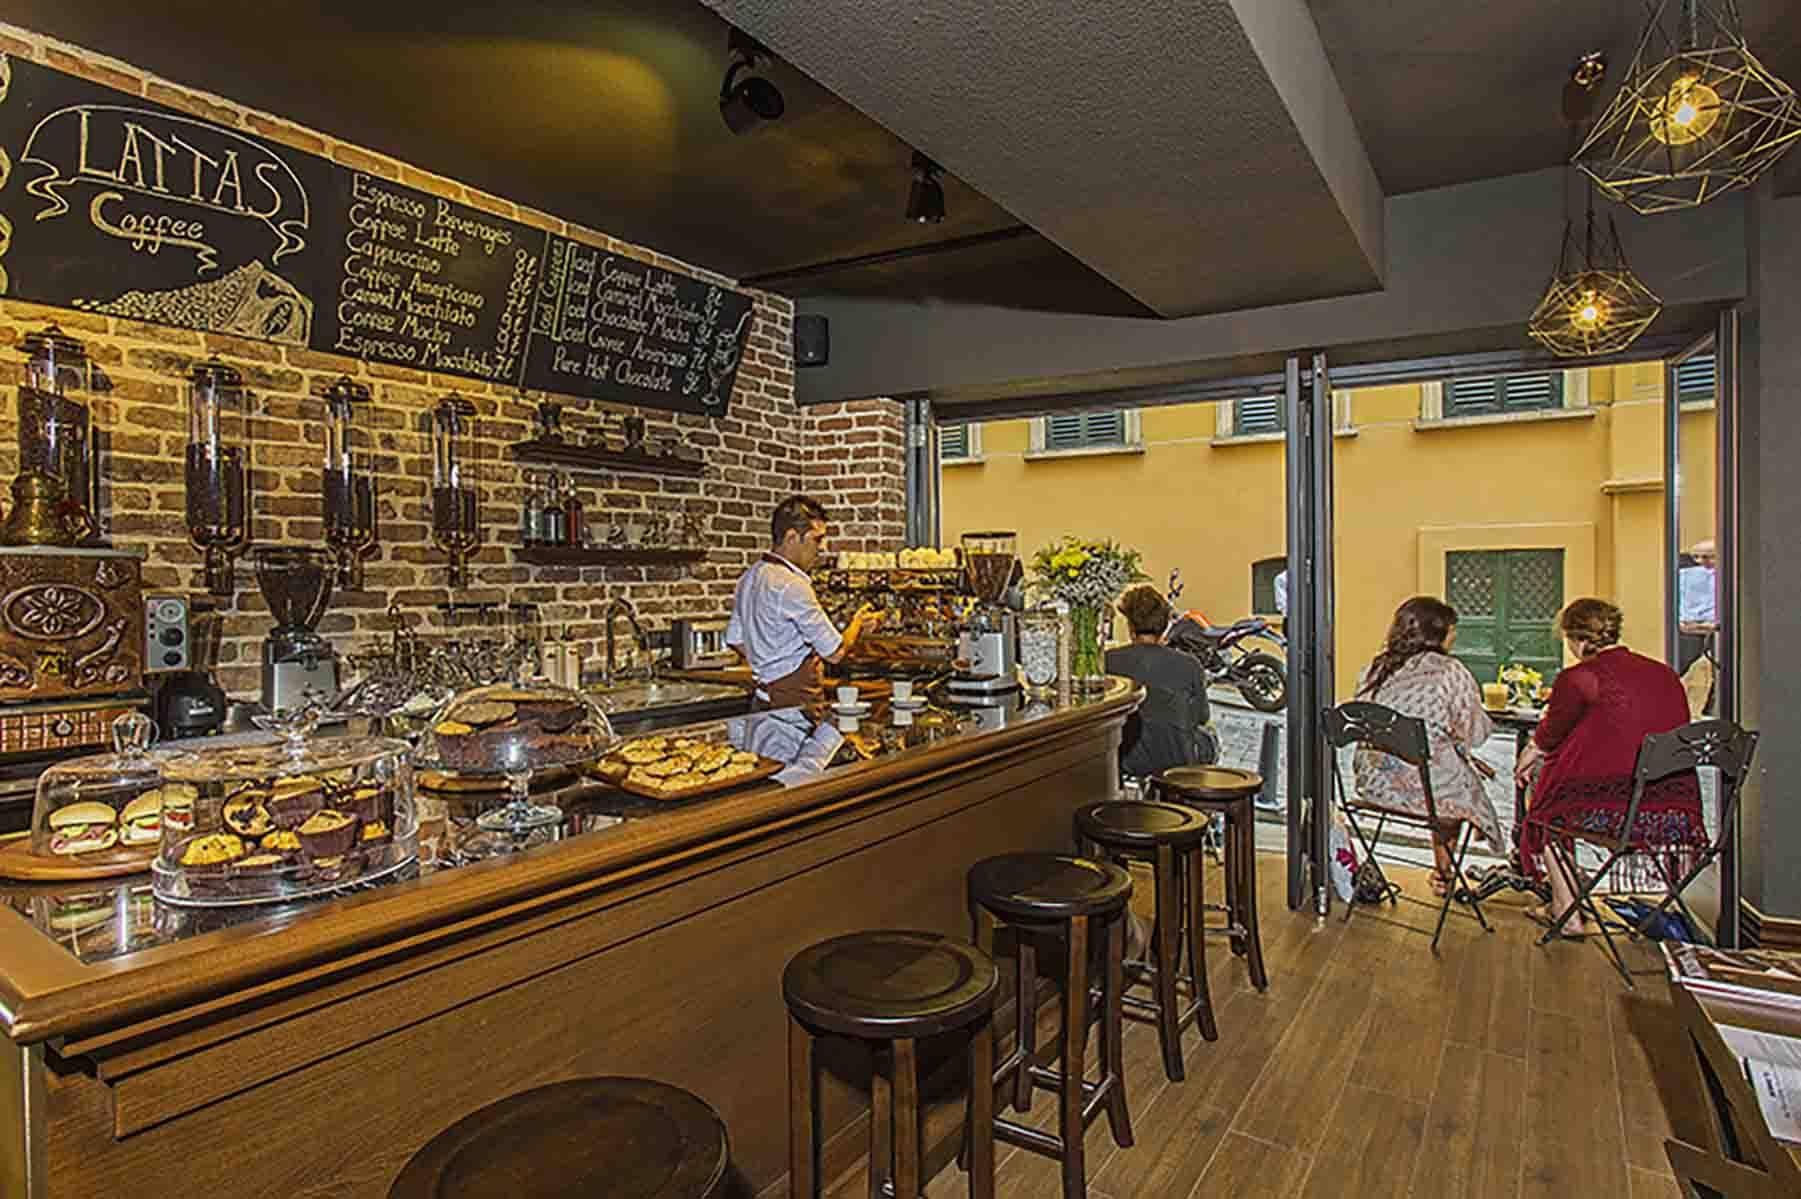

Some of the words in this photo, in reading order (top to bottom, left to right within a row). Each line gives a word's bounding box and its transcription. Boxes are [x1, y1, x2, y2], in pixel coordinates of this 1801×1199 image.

[77, 108, 281, 218] LATTAS
[90, 191, 213, 257] Coffee
[414, 221, 460, 256] Latte
[335, 327, 417, 361] Espresso
[400, 314, 451, 344] Mocha
[584, 352, 610, 379] Hot
